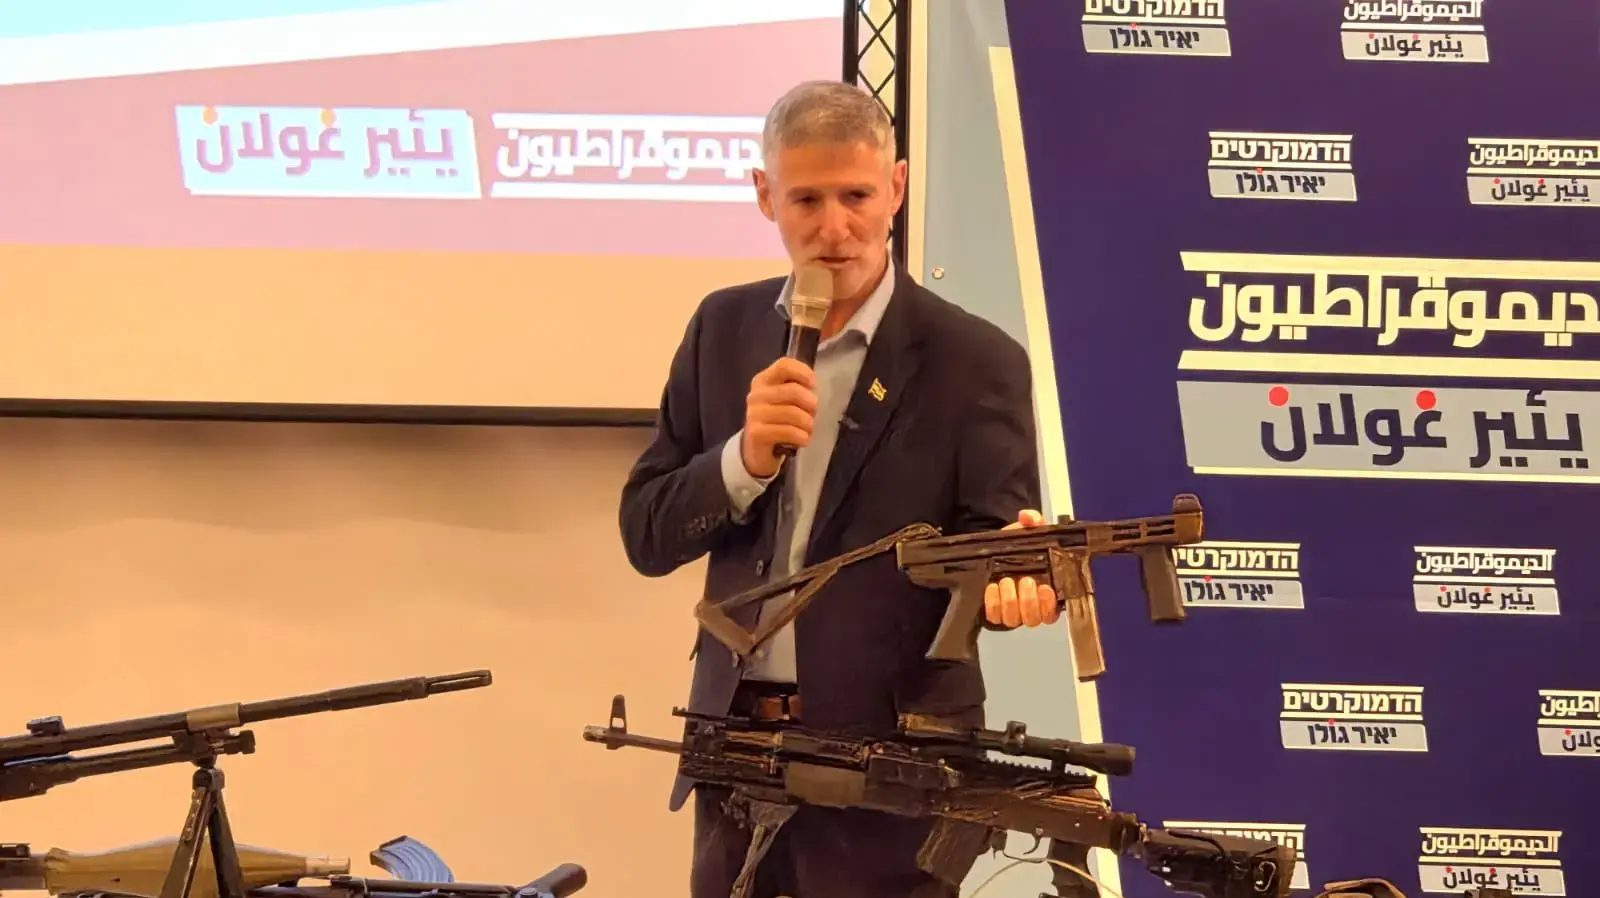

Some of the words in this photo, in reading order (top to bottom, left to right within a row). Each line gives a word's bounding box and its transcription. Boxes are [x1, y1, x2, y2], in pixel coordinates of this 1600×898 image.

[1085, 0, 1225, 18] הדמוקרטים
[1109, 23, 1153, 49] גולן
[1154, 30, 1200, 49] יאיר
[1365, 33, 1423, 57] غولان
[1427, 33, 1465, 58] يئير
[196, 106, 345, 177] غولان
[363, 109, 459, 178] يئير
[496, 126, 764, 180] ديموقراطيون
[1210, 139, 1350, 163] הדמוקרטים
[1469, 144, 1600, 167] لديموقراطيون
[1236, 167, 1279, 194] גולן
[1280, 175, 1326, 194] יאיר
[1491, 178, 1548, 202] غولان
[1553, 179, 1591, 202] يئير
[1188, 273, 1600, 348] ديموقراطيون
[1260, 386, 1448, 466] غولان
[1469, 389, 1589, 469] يئير
[1416, 551, 1553, 575] الديموقراطيون
[1184, 576, 1227, 602] גולן
[1228, 583, 1274, 602] יאיר
[1437, 585, 1494, 609] غولان
[1500, 586, 1536, 611] يئير
[1283, 691, 1423, 714] הדמוקרטים
[1307, 718, 1350, 745] גולן
[1351, 727, 1398, 745] יאיר
[1421, 832, 1559, 856] الديموقراطيون
[1443, 866, 1499, 889] غولان
[1506, 867, 1541, 891] يئير
